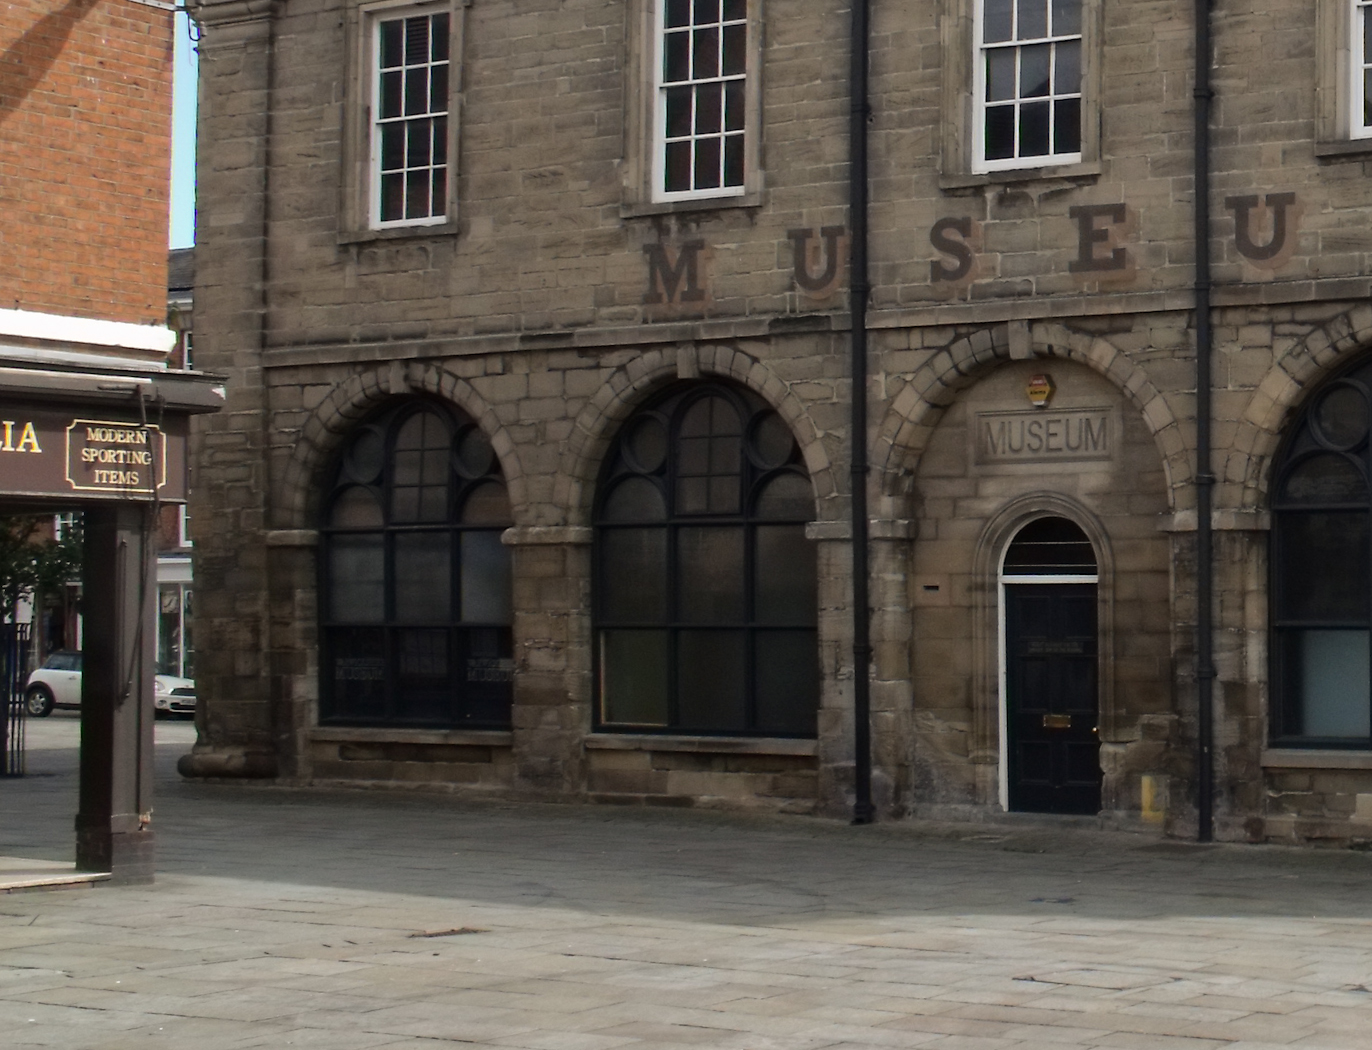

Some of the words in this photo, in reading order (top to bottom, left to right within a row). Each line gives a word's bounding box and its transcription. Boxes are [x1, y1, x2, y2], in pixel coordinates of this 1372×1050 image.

[0, 421, 42, 453] IA
[86, 427, 147, 444] MODERN
[984, 418, 1106, 454] MUSEUM
[82, 448, 152, 465] SPORTING
[94, 469, 140, 485] ITEMS
